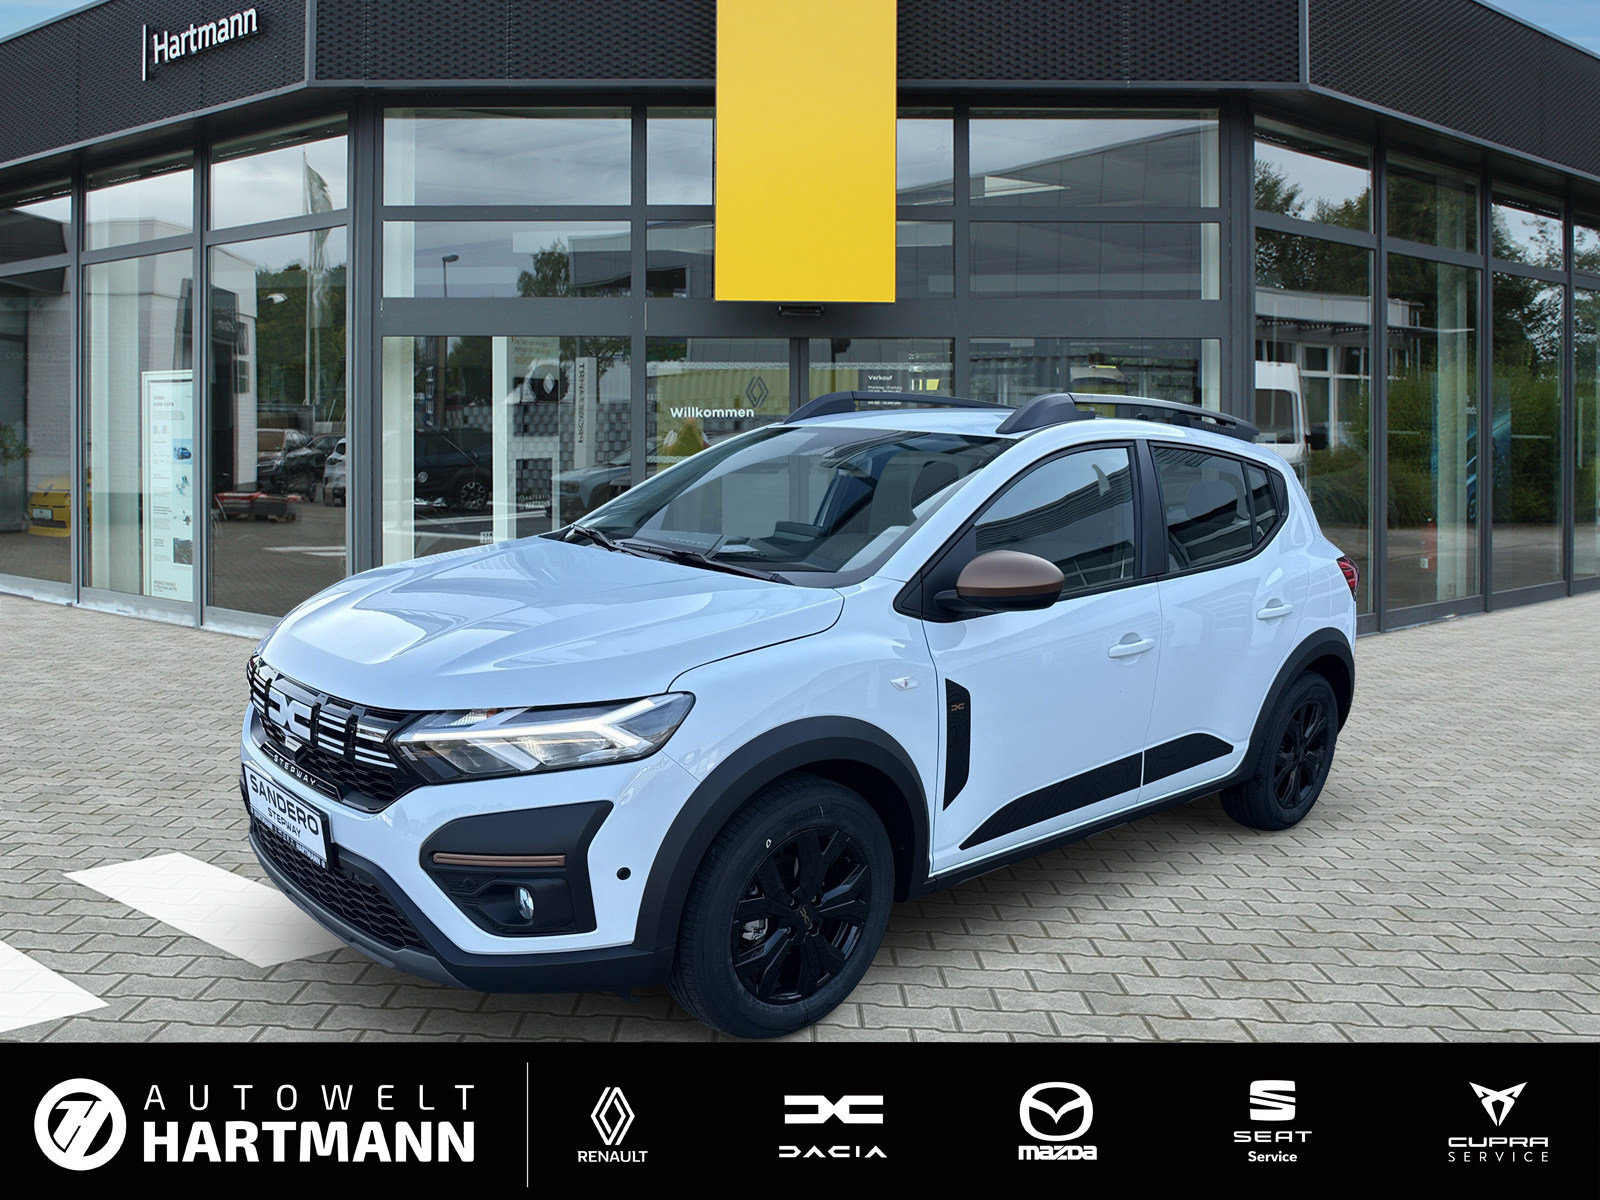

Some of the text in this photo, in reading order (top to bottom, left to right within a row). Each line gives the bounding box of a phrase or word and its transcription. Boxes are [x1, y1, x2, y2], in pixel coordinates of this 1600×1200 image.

[153, 8, 258, 64] Hartmann
[669, 406, 755, 418] Willkommen
[273, 754, 316, 786] STEPWAY
[249, 773, 319, 836] SANDERO
[267, 807, 301, 838] STEPWAY
